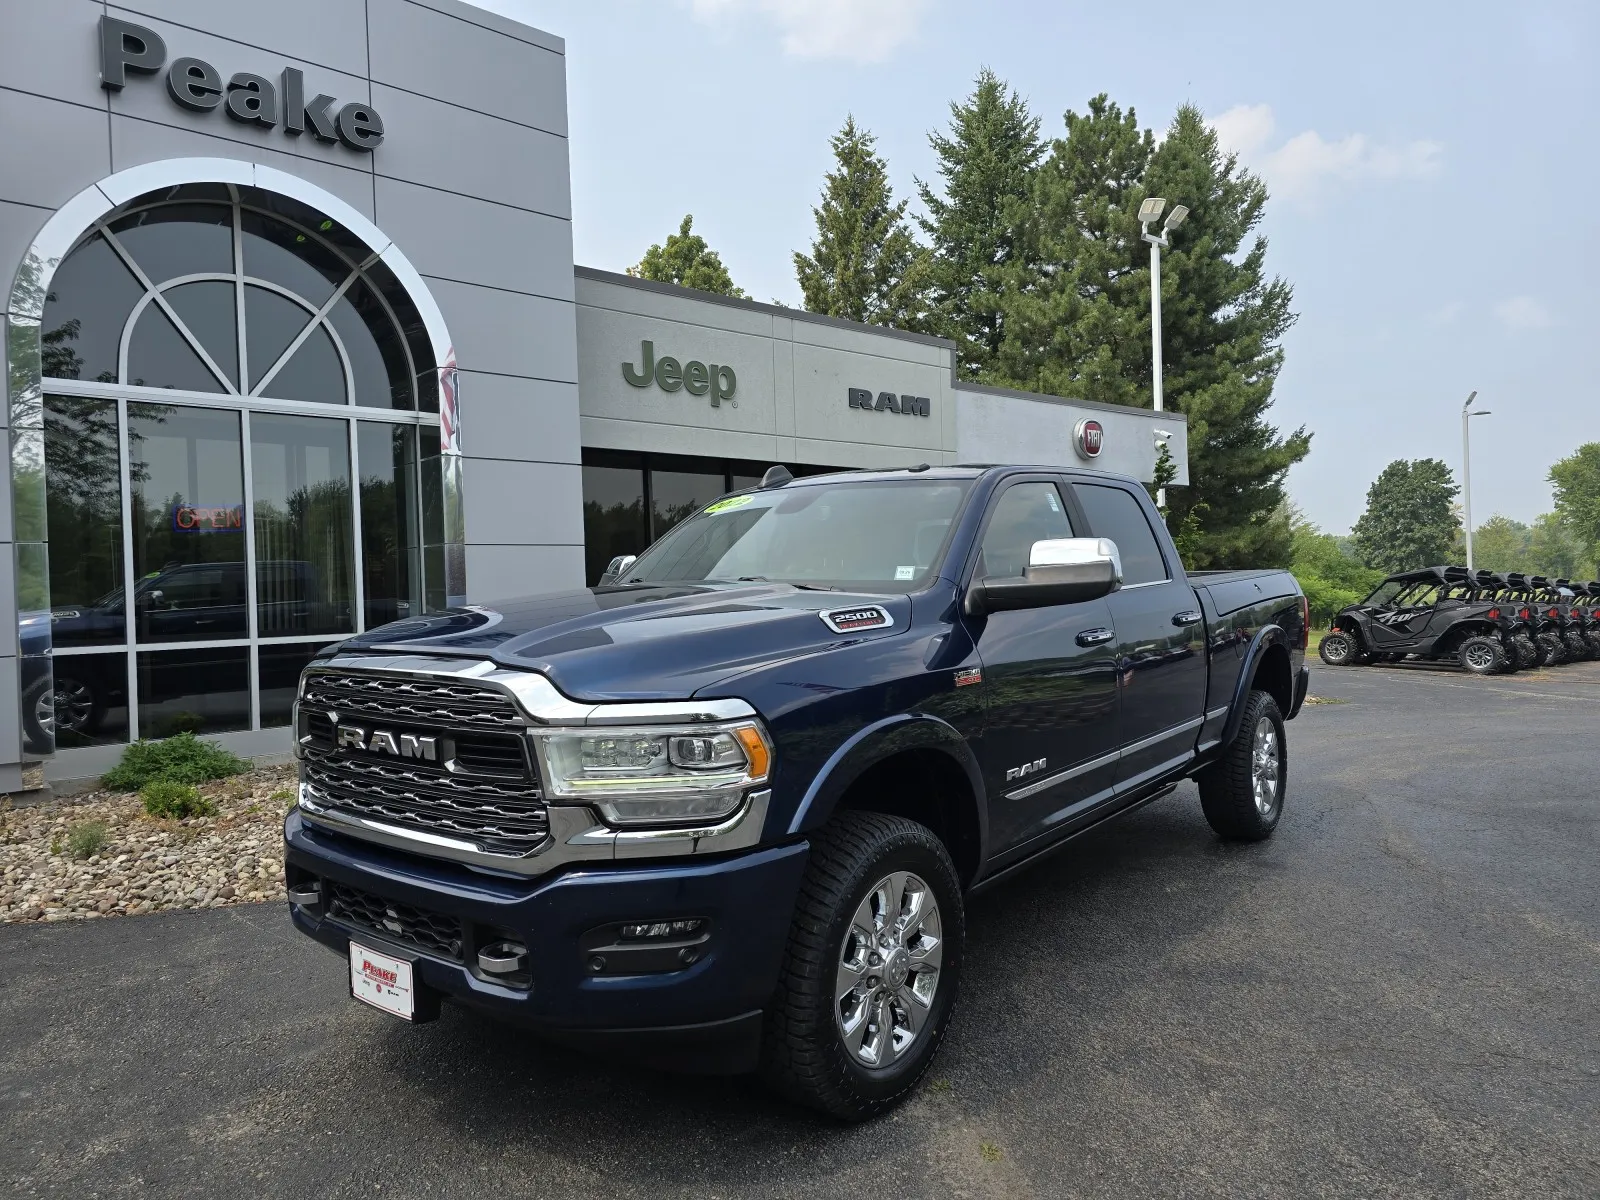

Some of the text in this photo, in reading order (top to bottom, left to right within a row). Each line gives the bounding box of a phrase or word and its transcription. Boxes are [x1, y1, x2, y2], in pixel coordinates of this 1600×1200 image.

[98, 15, 384, 152] Peake
[622, 340, 737, 407] Jeep
[848, 387, 931, 417] RAM
[1087, 429, 1101, 448] FIAT
[177, 507, 241, 529] OPEN
[833, 610, 878, 623] 2500
[338, 725, 437, 760] RAM
[1006, 757, 1047, 781] RAM
